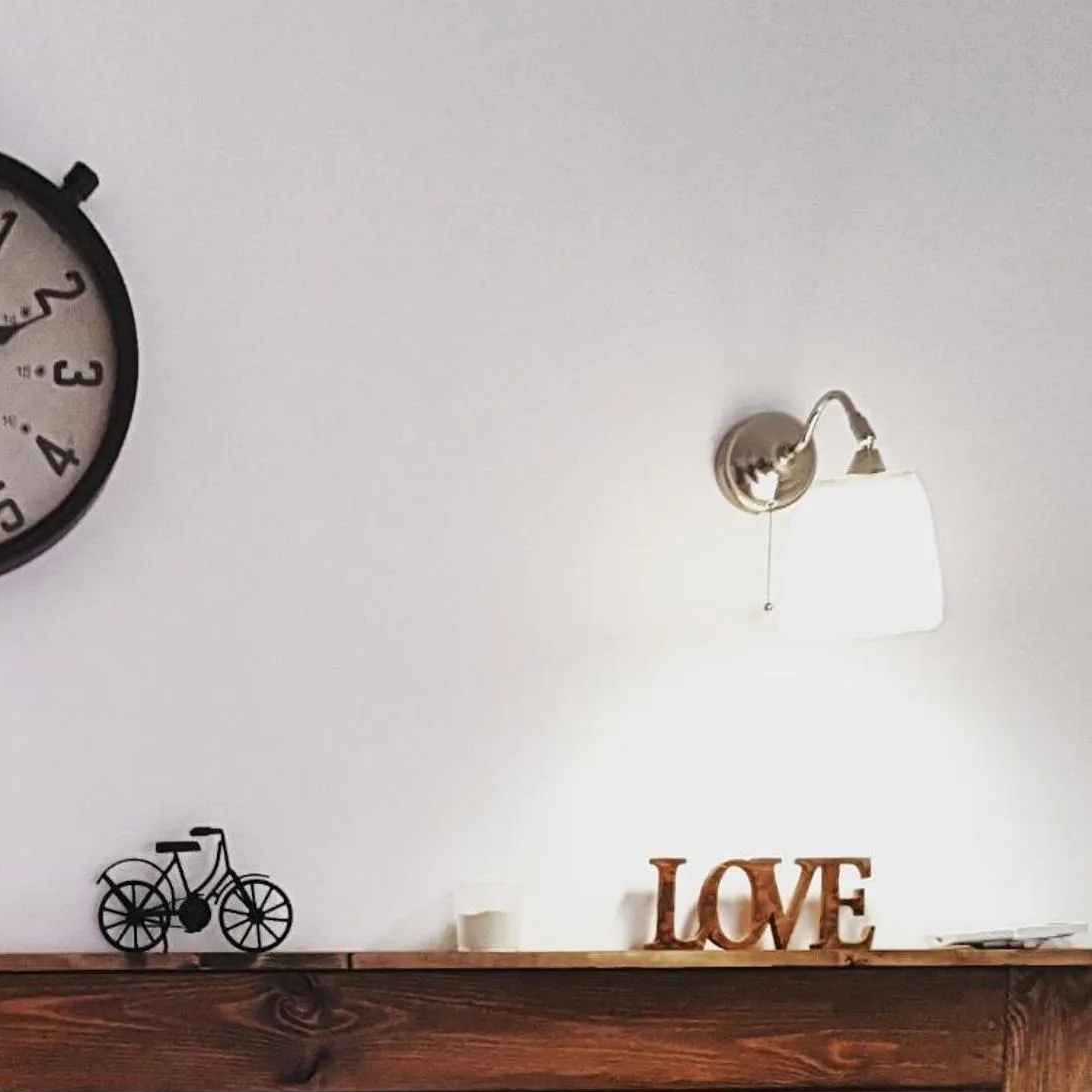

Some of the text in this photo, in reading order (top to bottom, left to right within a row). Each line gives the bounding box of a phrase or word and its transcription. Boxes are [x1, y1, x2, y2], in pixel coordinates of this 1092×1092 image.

[34, 268, 87, 316] 2
[52, 359, 104, 387] 3
[35, 434, 81, 478] 4
[643, 856, 876, 951] LOVE
